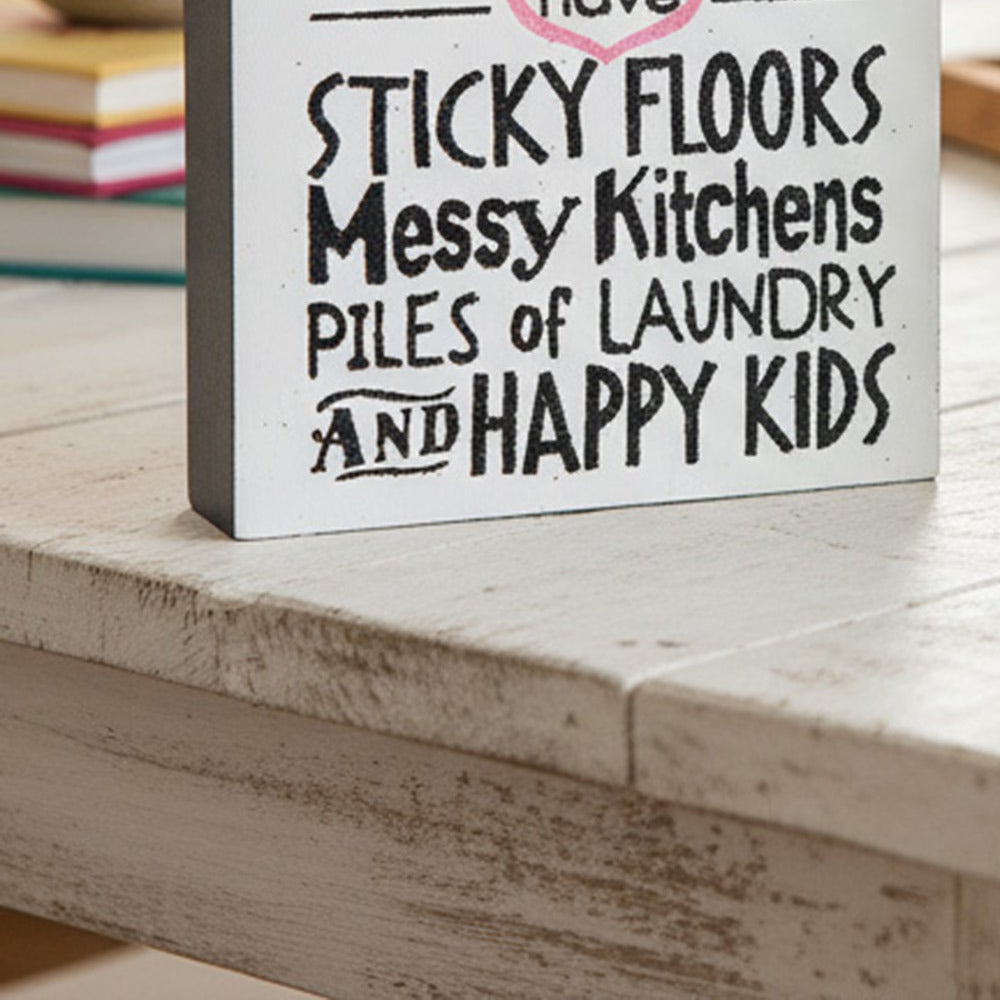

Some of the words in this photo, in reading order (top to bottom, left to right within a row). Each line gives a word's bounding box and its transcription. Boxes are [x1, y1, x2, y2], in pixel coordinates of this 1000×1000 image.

[308, 58, 598, 179] STICKY
[626, 45, 885, 156] FLOORS
[308, 182, 581, 285] Messy
[595, 159, 882, 265] Kitchens
[308, 291, 479, 379] PILES
[511, 286, 572, 359] of
[600, 263, 895, 354] LAUNDRY
[311, 403, 460, 474] AND
[471, 361, 718, 476] HAPPY
[744, 343, 896, 457] KIDS
